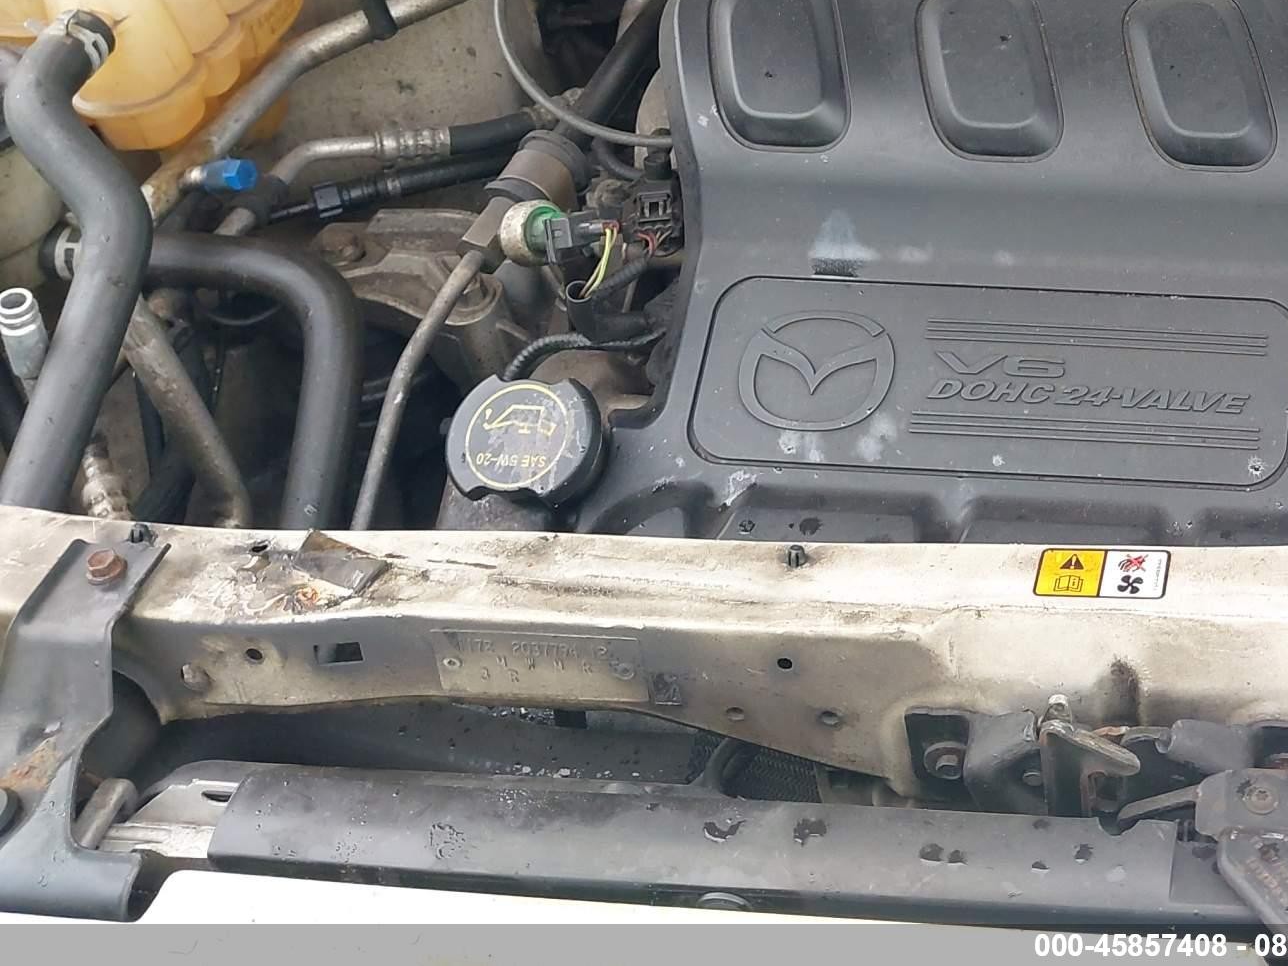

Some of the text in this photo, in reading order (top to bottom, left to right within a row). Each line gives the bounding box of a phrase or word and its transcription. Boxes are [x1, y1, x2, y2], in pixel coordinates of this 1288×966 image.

[934, 351, 1066, 378] V6
[926, 378, 1251, 414] DOHC 24-VALVE
[475, 452, 547, 468] SAE 5W-20
